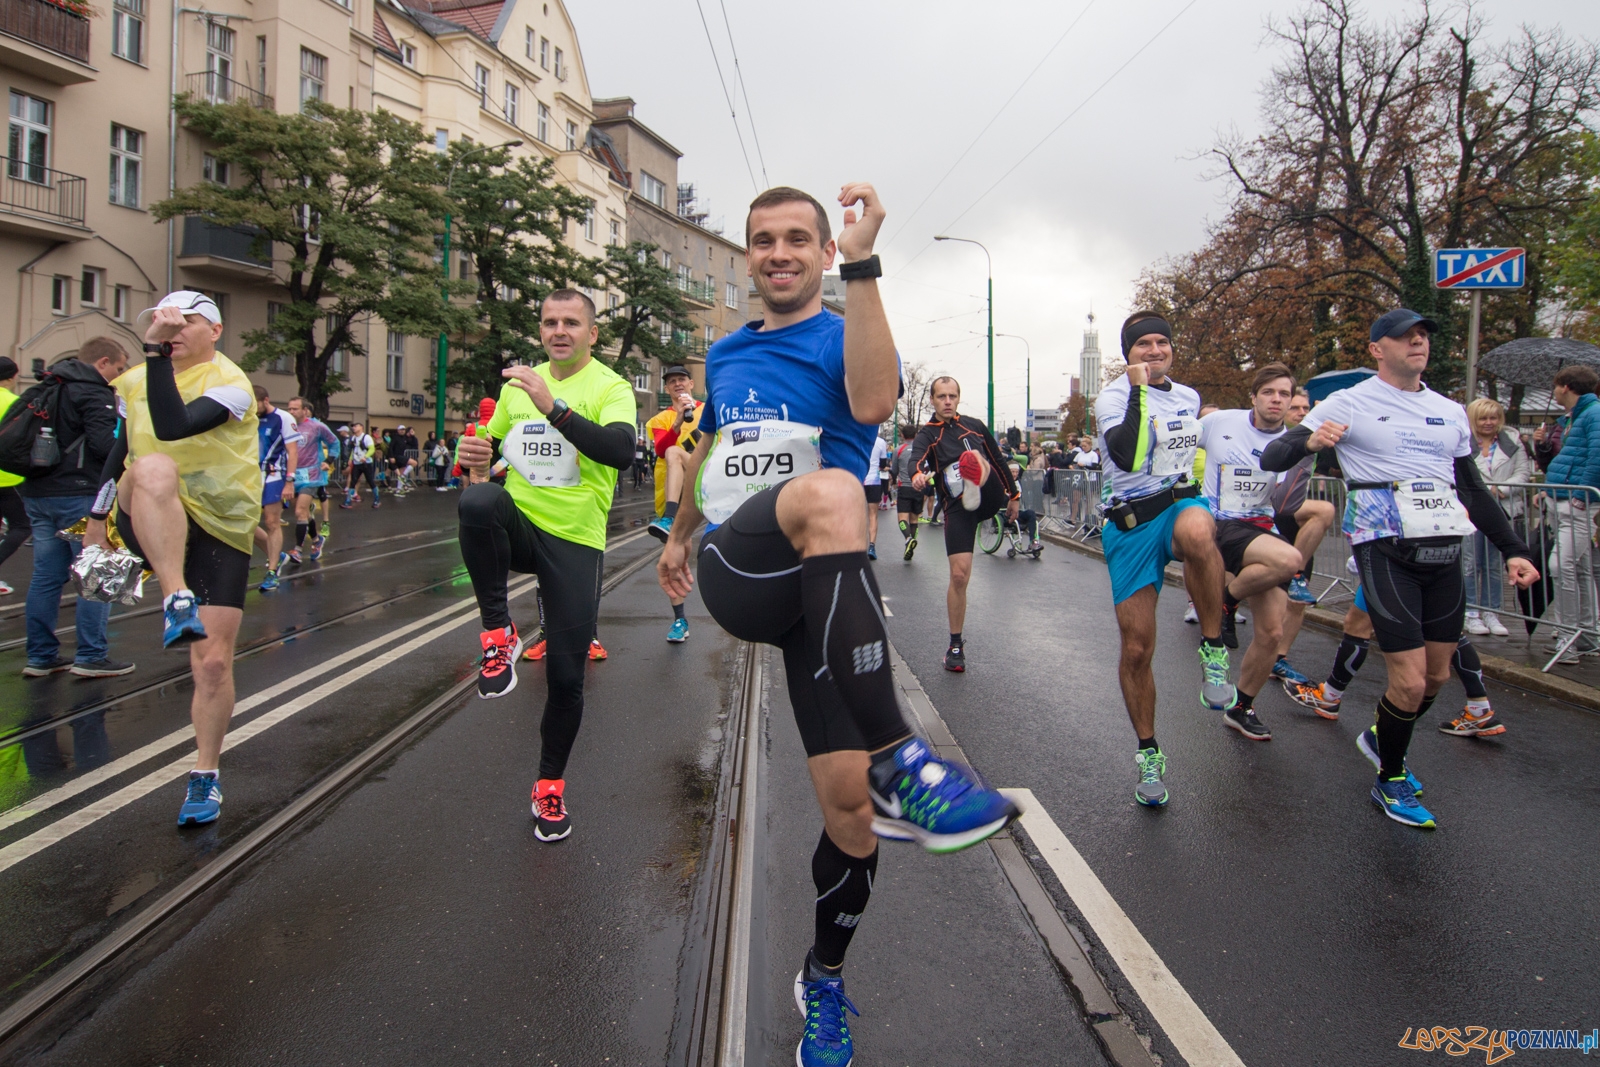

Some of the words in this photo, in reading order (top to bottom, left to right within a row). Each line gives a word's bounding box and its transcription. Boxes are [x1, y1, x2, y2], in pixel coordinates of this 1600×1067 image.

[1439, 253, 1520, 284] TAXI
[390, 398, 410, 408] cafe
[725, 407, 743, 420] 15.
[743, 412, 779, 421] MARATON
[1168, 434, 1197, 450] 2289
[522, 442, 562, 457] 1983
[725, 452, 794, 477] 6079
[1234, 481, 1268, 491] 3977
